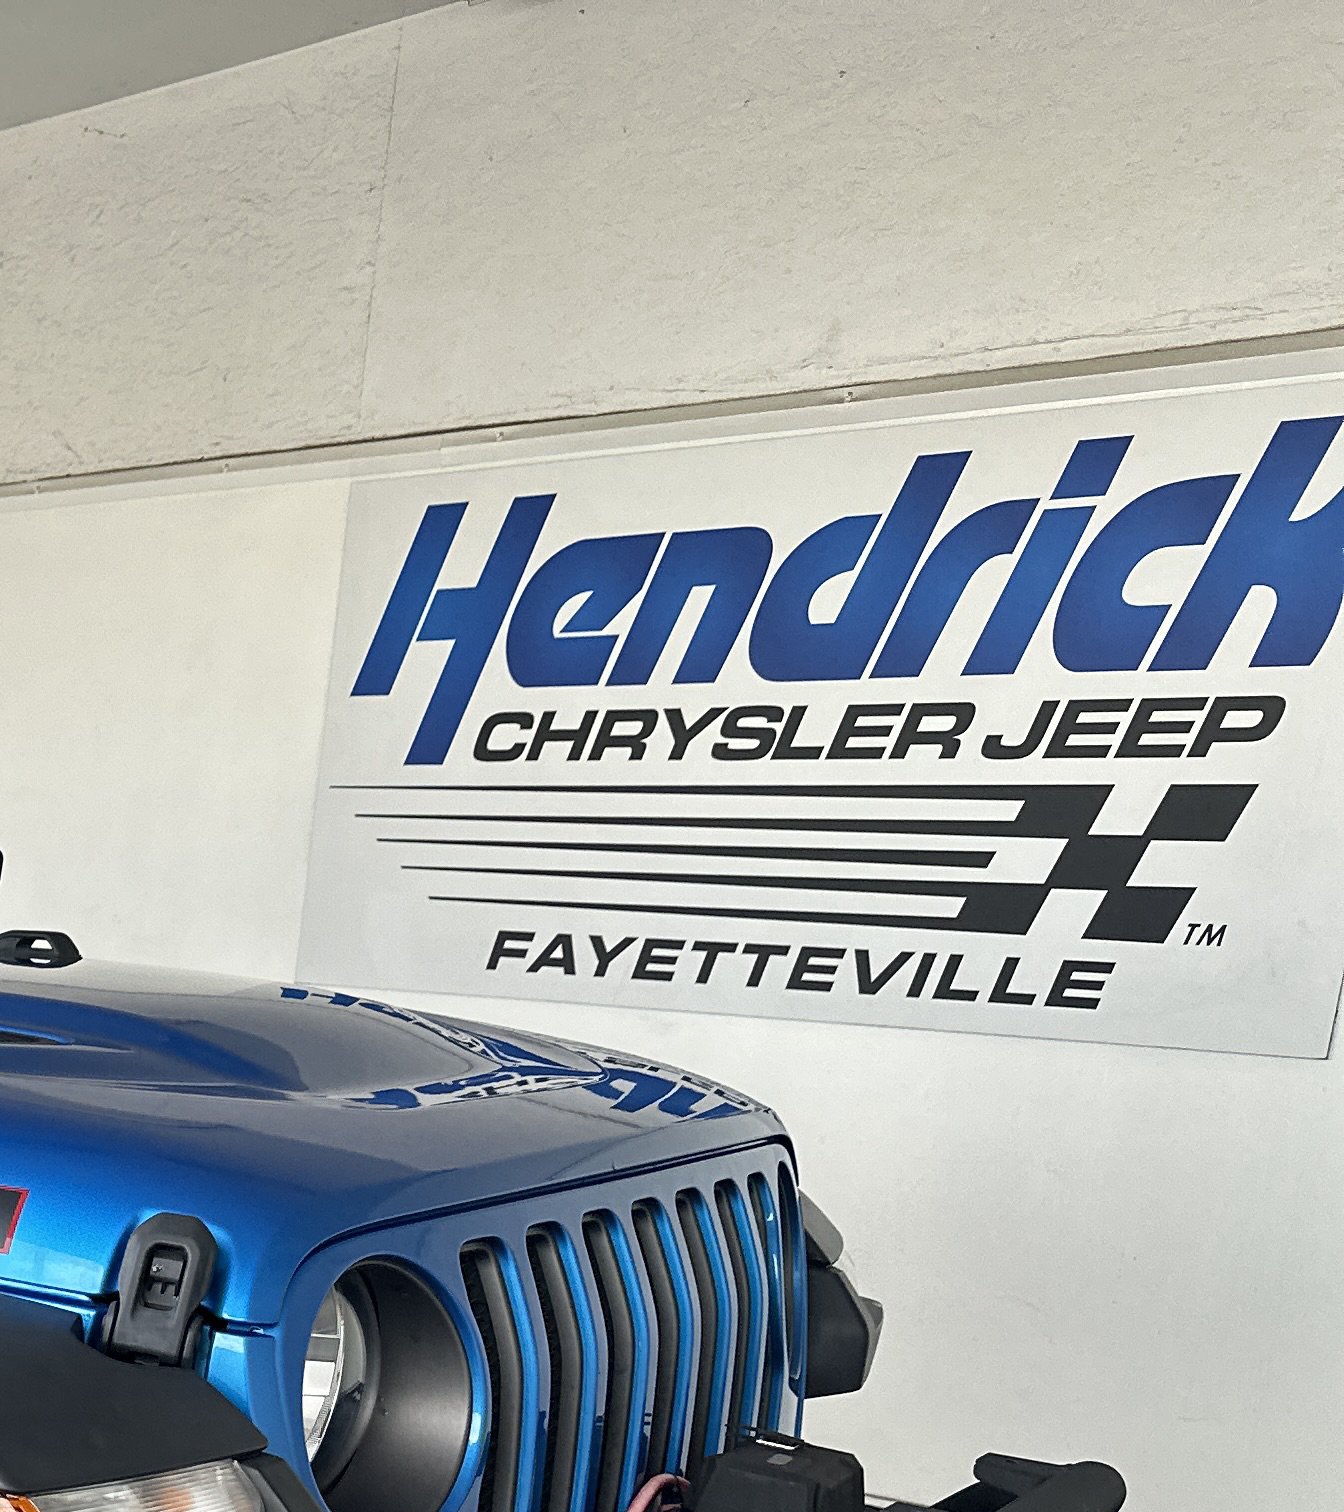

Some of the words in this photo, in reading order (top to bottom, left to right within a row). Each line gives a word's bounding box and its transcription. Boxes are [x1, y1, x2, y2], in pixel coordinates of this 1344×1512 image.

[350, 414, 1344, 766] Hendrick
[472, 701, 976, 763] CHRYSLER
[980, 694, 1287, 760] JEEP
[485, 929, 1117, 1010] FAYETTEVILLE
[1183, 922, 1227, 948] TM
